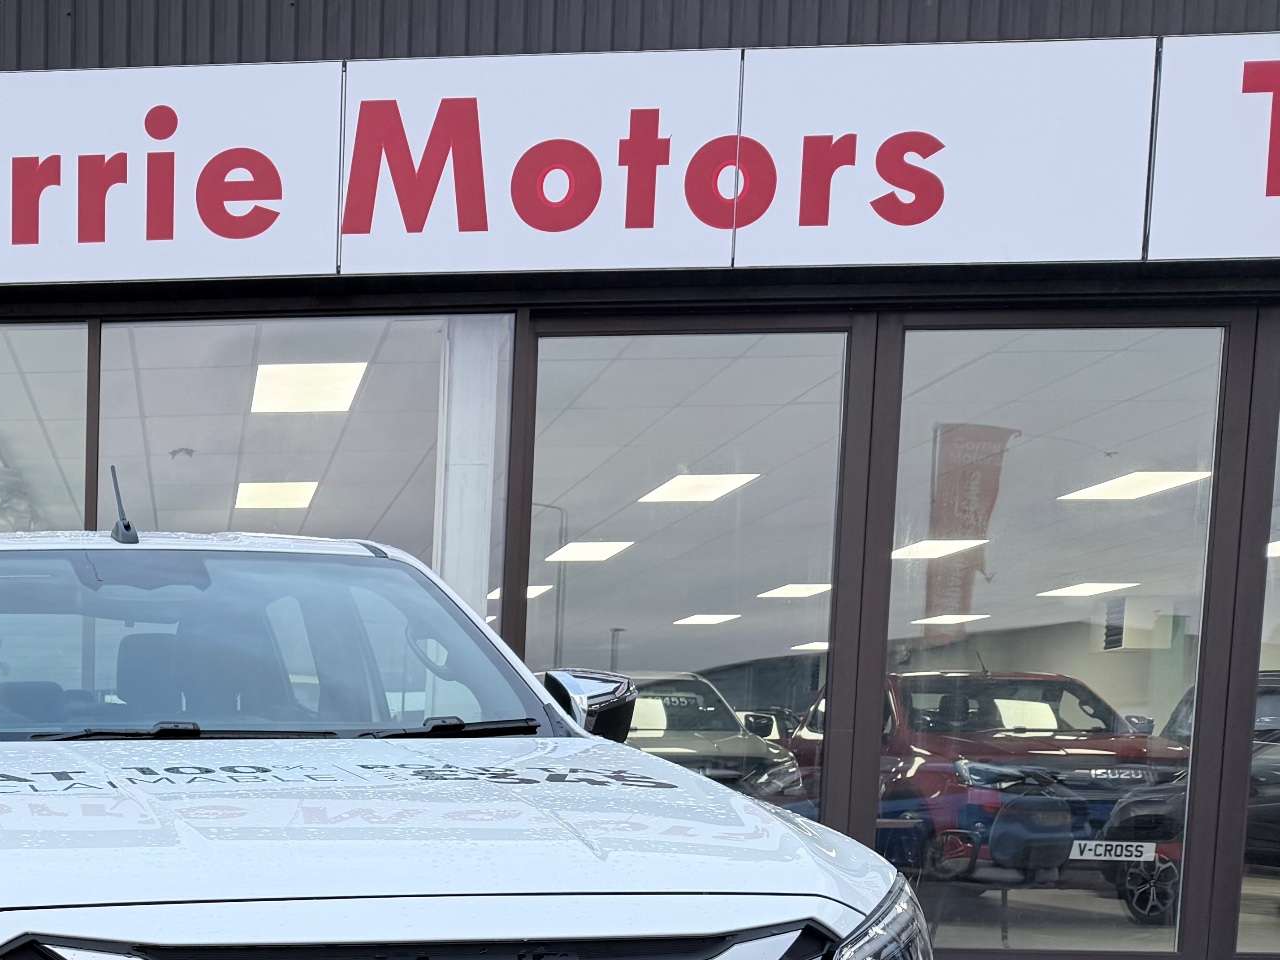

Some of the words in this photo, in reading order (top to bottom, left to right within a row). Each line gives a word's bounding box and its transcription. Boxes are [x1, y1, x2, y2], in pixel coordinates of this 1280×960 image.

[341, 96, 946, 234] Motors
[121, 764, 318, 776] 100%
[356, 763, 516, 773] ROAD
[1090, 768, 1143, 779] ISUZU
[1078, 842, 1145, 858] V-CROSS
